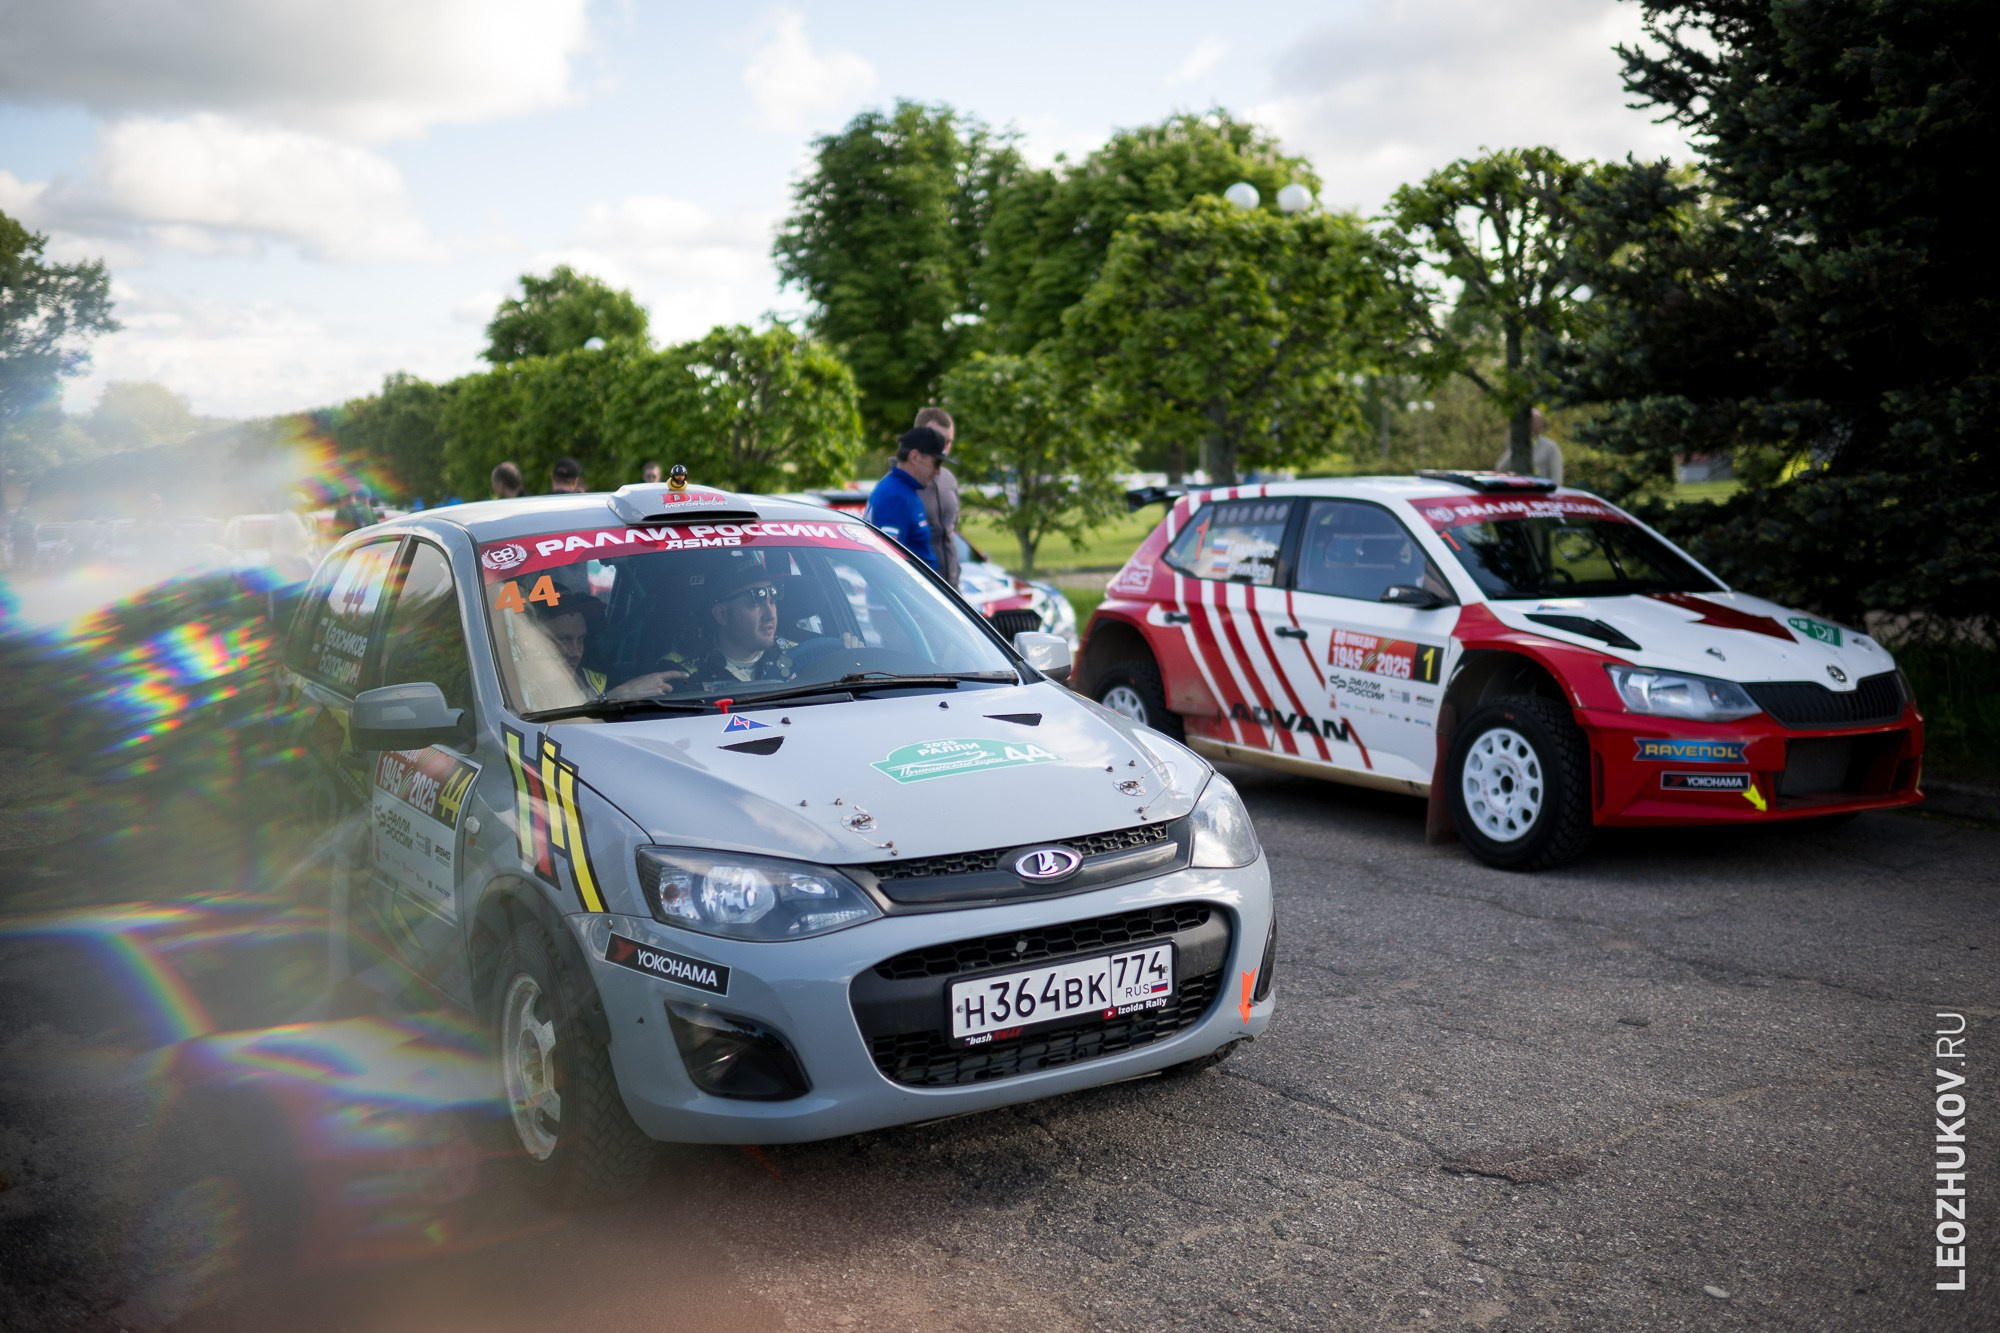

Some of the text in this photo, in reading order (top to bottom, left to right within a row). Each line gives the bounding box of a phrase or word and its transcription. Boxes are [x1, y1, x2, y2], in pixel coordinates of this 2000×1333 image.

[1455, 502, 1528, 518] РАЛЛИ
[535, 527, 681, 557] РАЛЛИ
[688, 524, 838, 539] РОССИИ
[1195, 518, 1209, 560] 1
[495, 575, 561, 614] 44
[1333, 645, 1411, 679] 1945 2025
[1423, 648, 1435, 681] 1
[1346, 687, 1385, 702] РОССИИ
[1349, 676, 1381, 691] РАЛЛИ
[1230, 702, 1349, 742] ADVAN
[917, 742, 980, 756] РАЛЛИ
[922, 740, 957, 749] 2025
[1004, 744, 1057, 762] 44
[1645, 744, 1738, 758] RAVENOL
[380, 756, 440, 815] 1945 2025
[1686, 776, 1742, 787] YOKOHAMA
[438, 767, 474, 824] 44
[387, 810, 411, 834] РАЛЛИ
[386, 824, 413, 851] РОССИИ
[637, 949, 718, 987] YOKOHAMA
[1113, 951, 1164, 988] 774
[1125, 986, 1150, 998] RUS
[1118, 998, 1167, 1015] Izolda Rally
